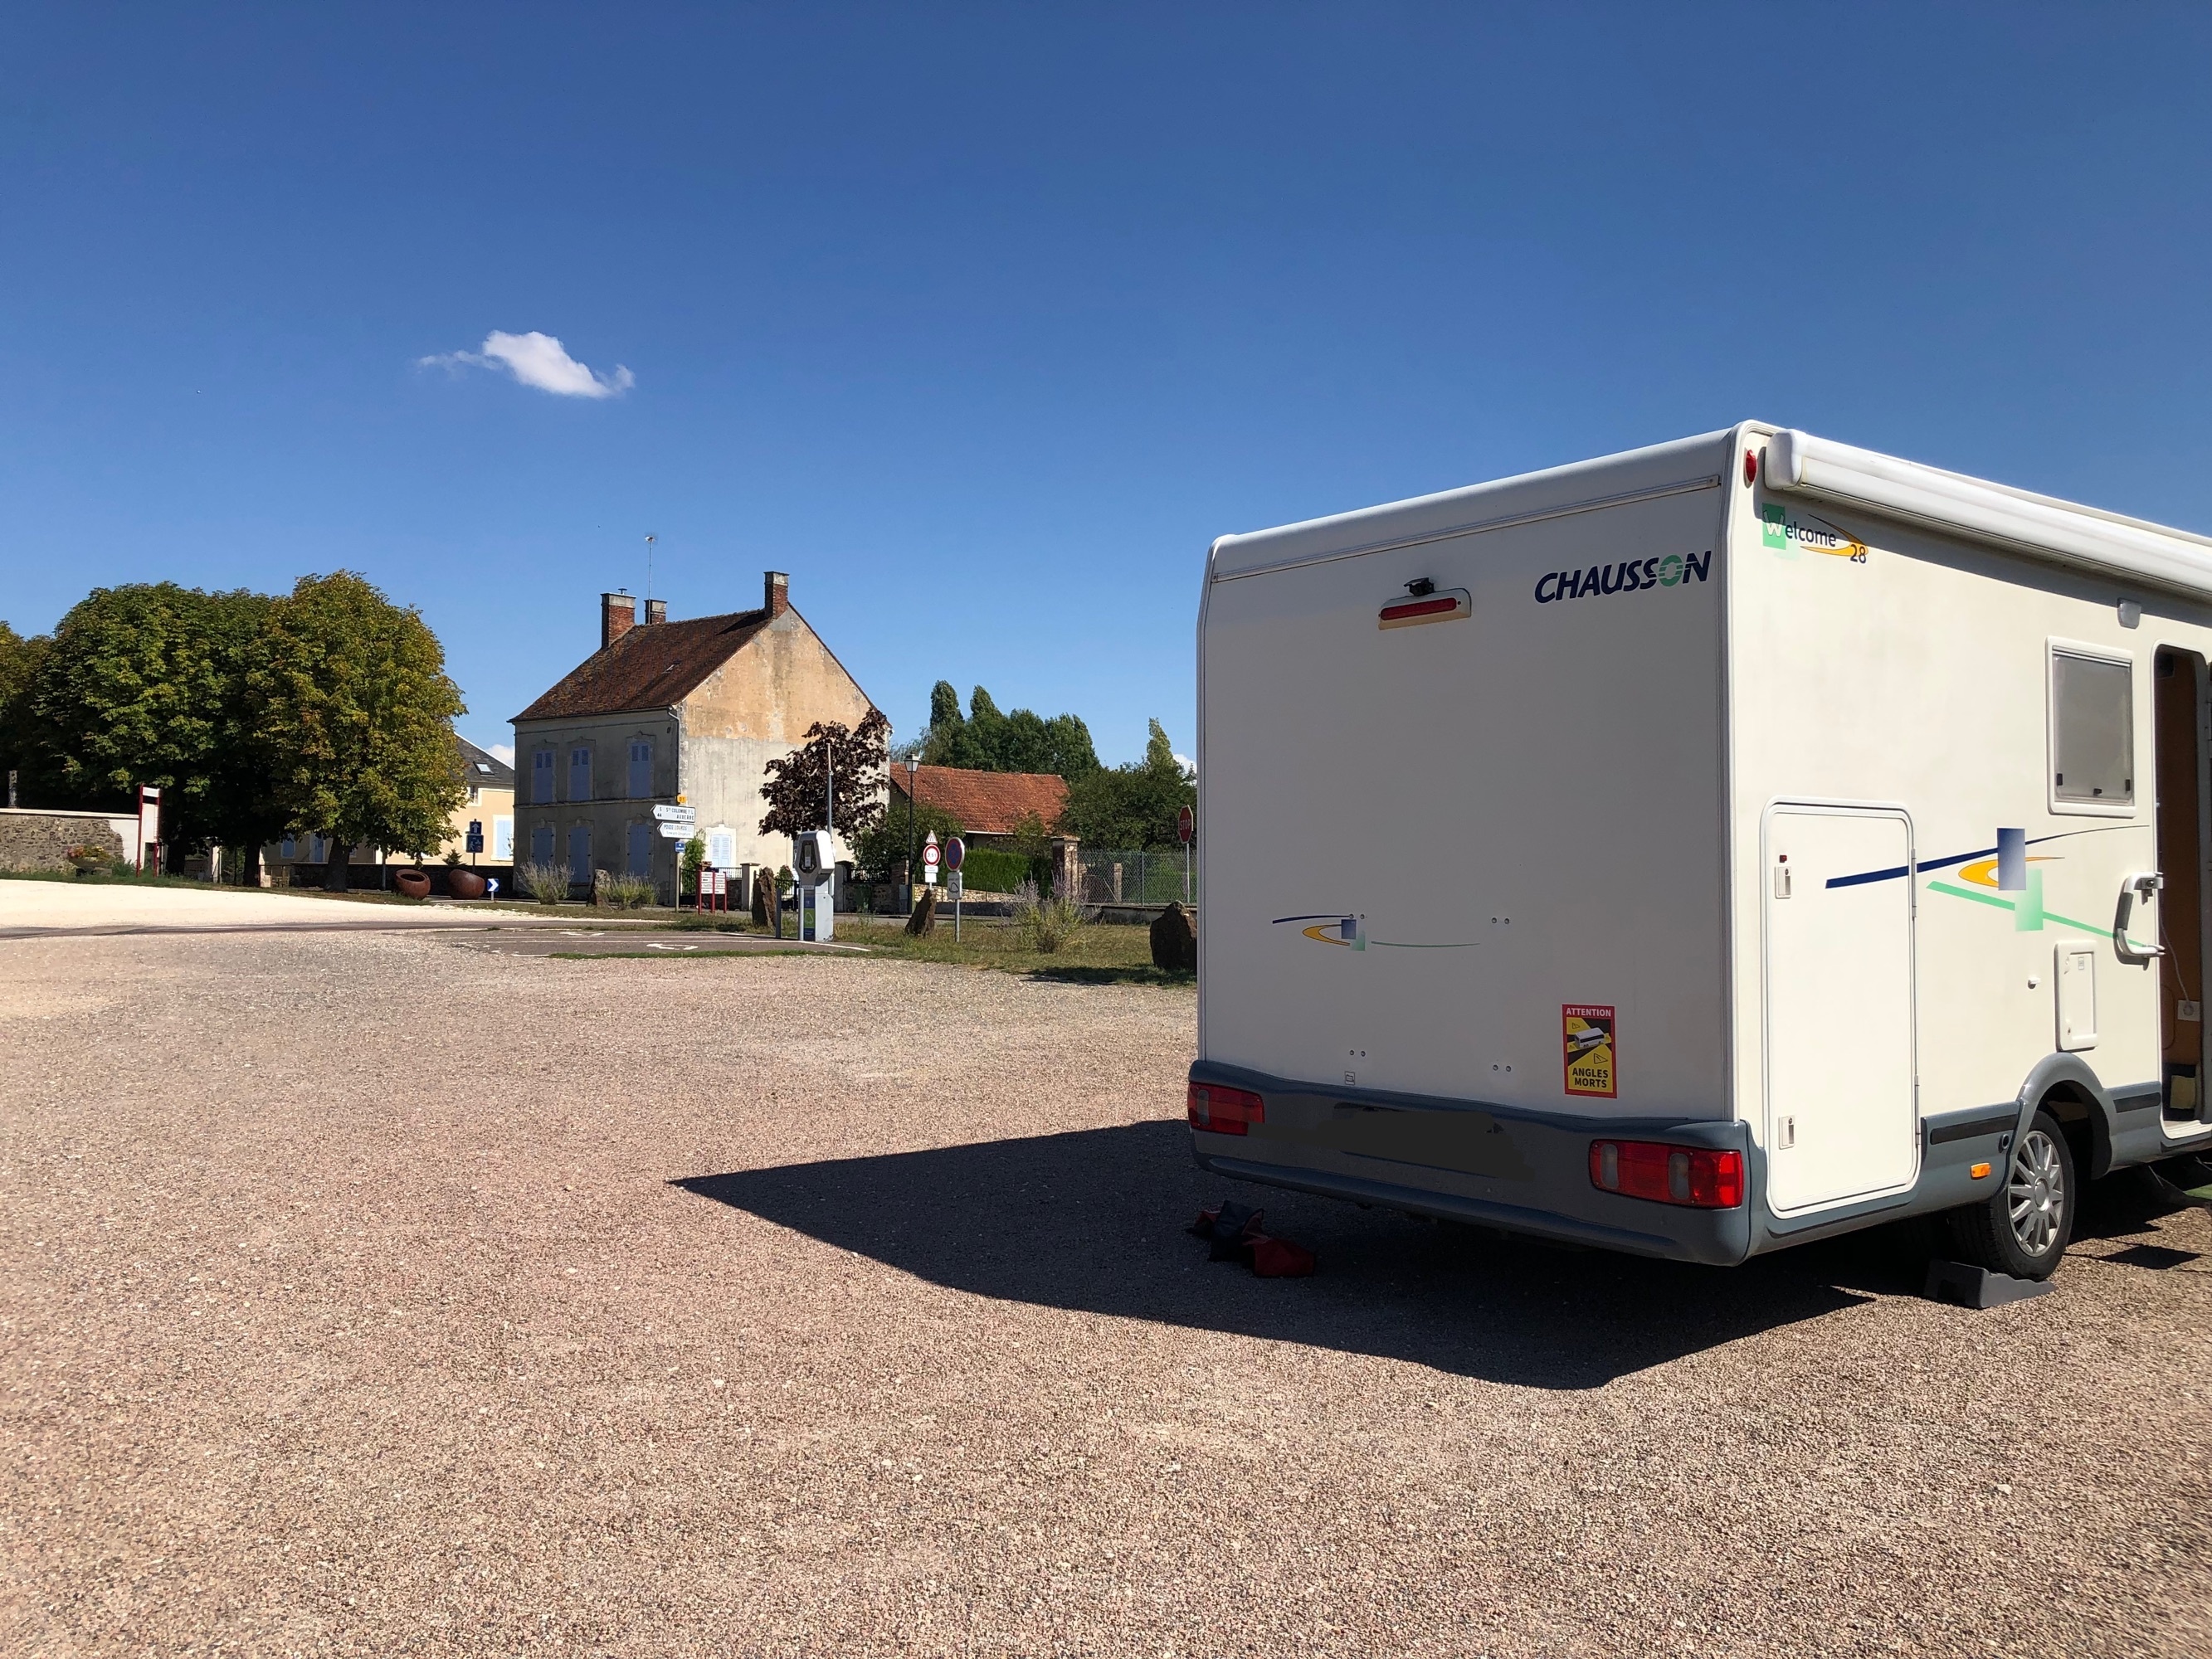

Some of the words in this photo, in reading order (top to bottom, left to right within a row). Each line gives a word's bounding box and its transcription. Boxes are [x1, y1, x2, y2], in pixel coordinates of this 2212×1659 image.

[1763, 510, 1836, 547] Welcome
[1849, 544, 1867, 564] 28
[1535, 551, 1712, 603] CHAUSSON
[1180, 819, 1191, 830] STOP
[1566, 1008, 1611, 1017] ATTENTION
[1572, 1068, 1609, 1078] ANGLES
[1574, 1078, 1607, 1088] MORTS
